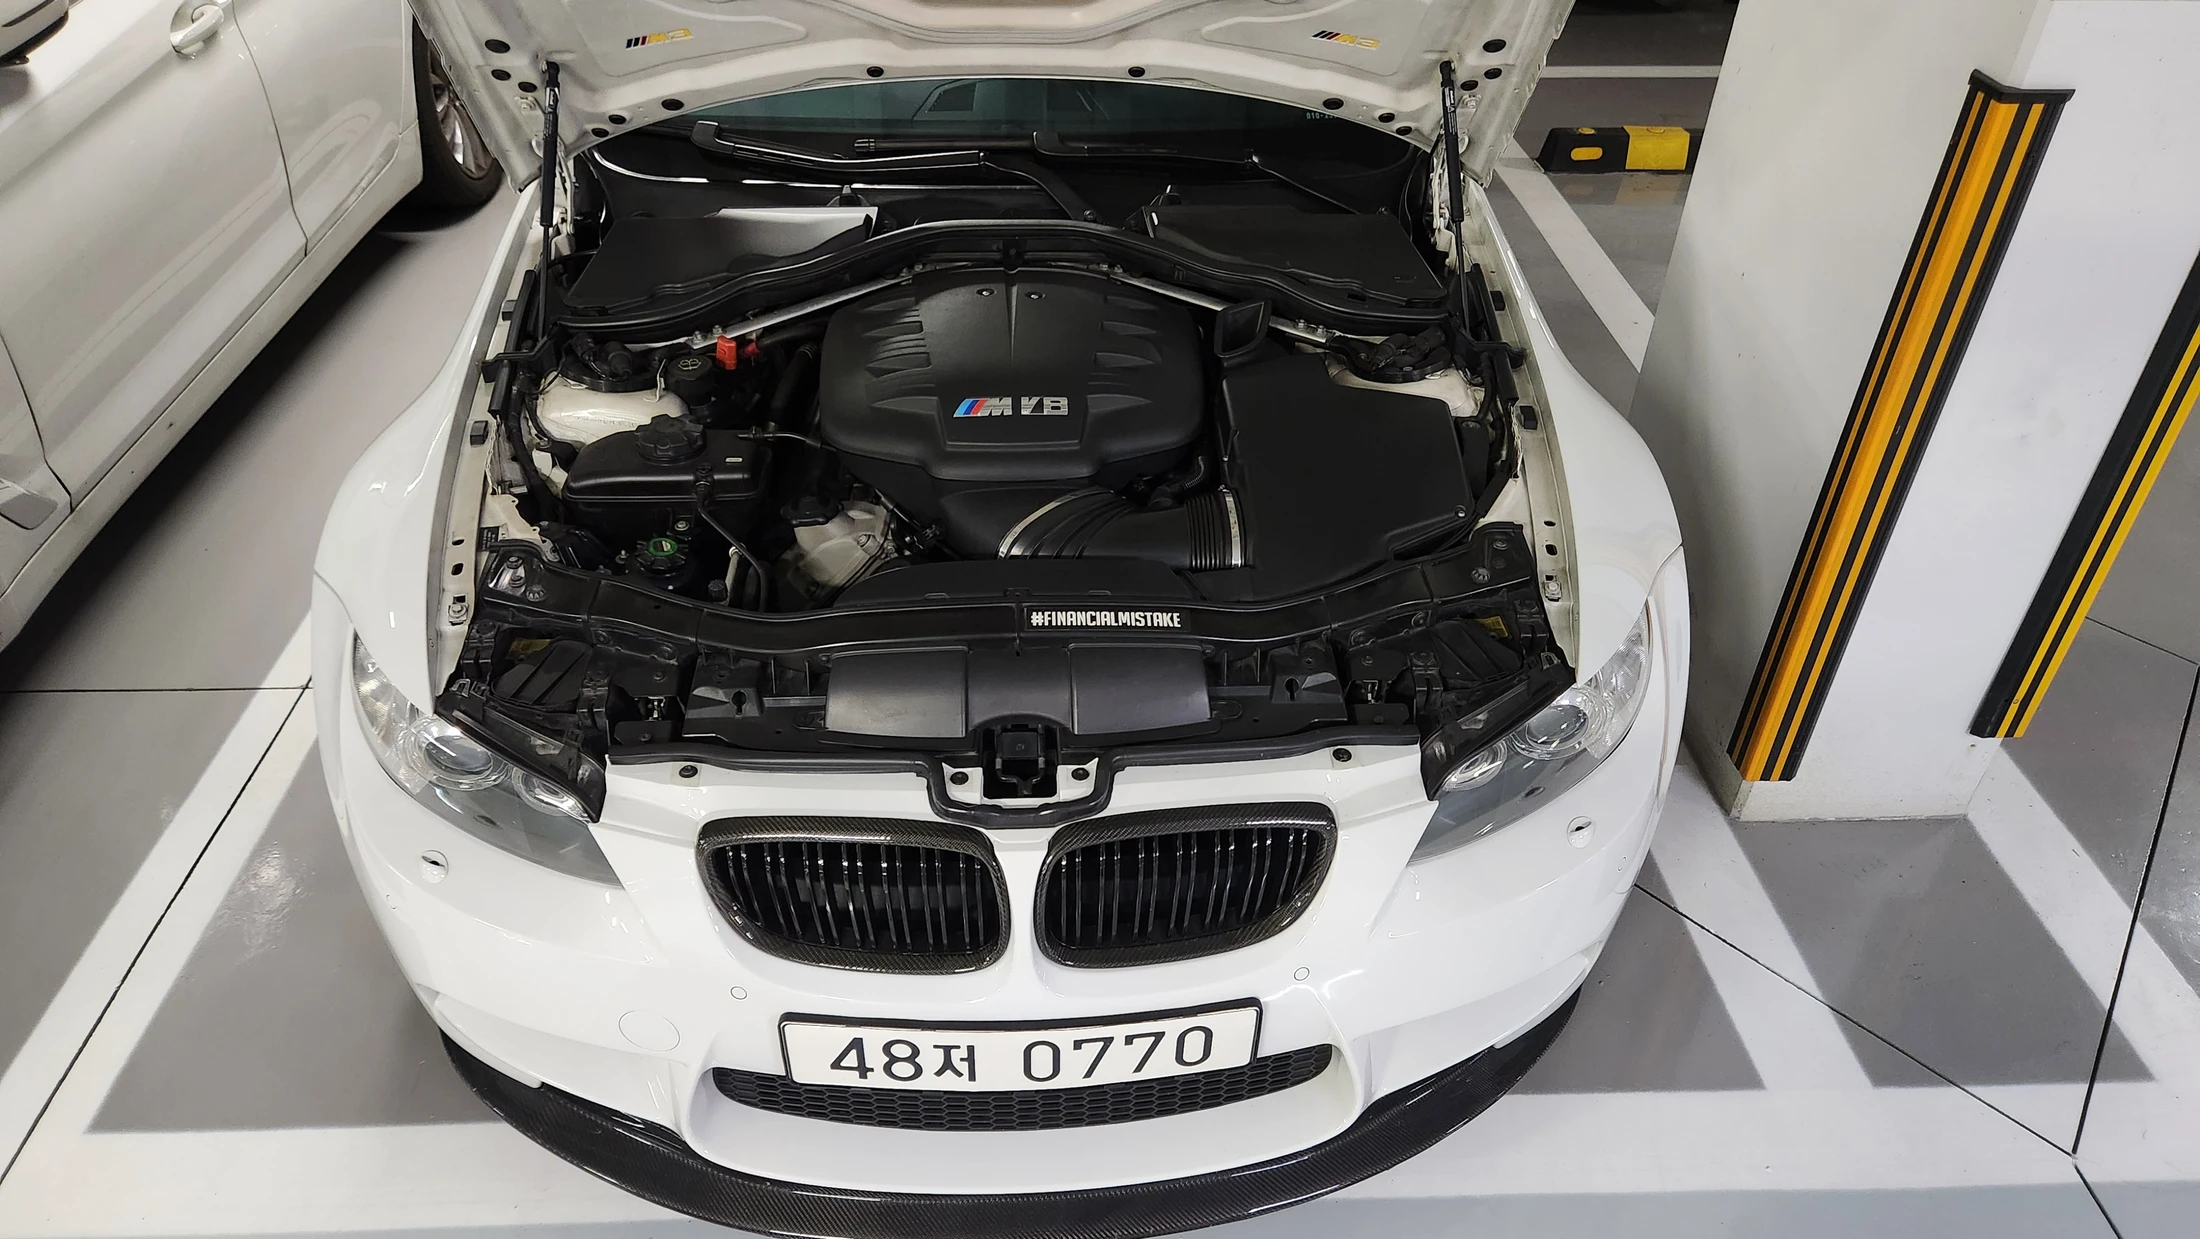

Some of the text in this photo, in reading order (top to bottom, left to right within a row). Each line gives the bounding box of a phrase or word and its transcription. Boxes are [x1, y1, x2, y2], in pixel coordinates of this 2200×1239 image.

[1021, 396, 1069, 416] V8
[1030, 610, 1182, 628] #FINANCIALMISTAKE
[829, 1025, 1215, 1083] 48저 0770
